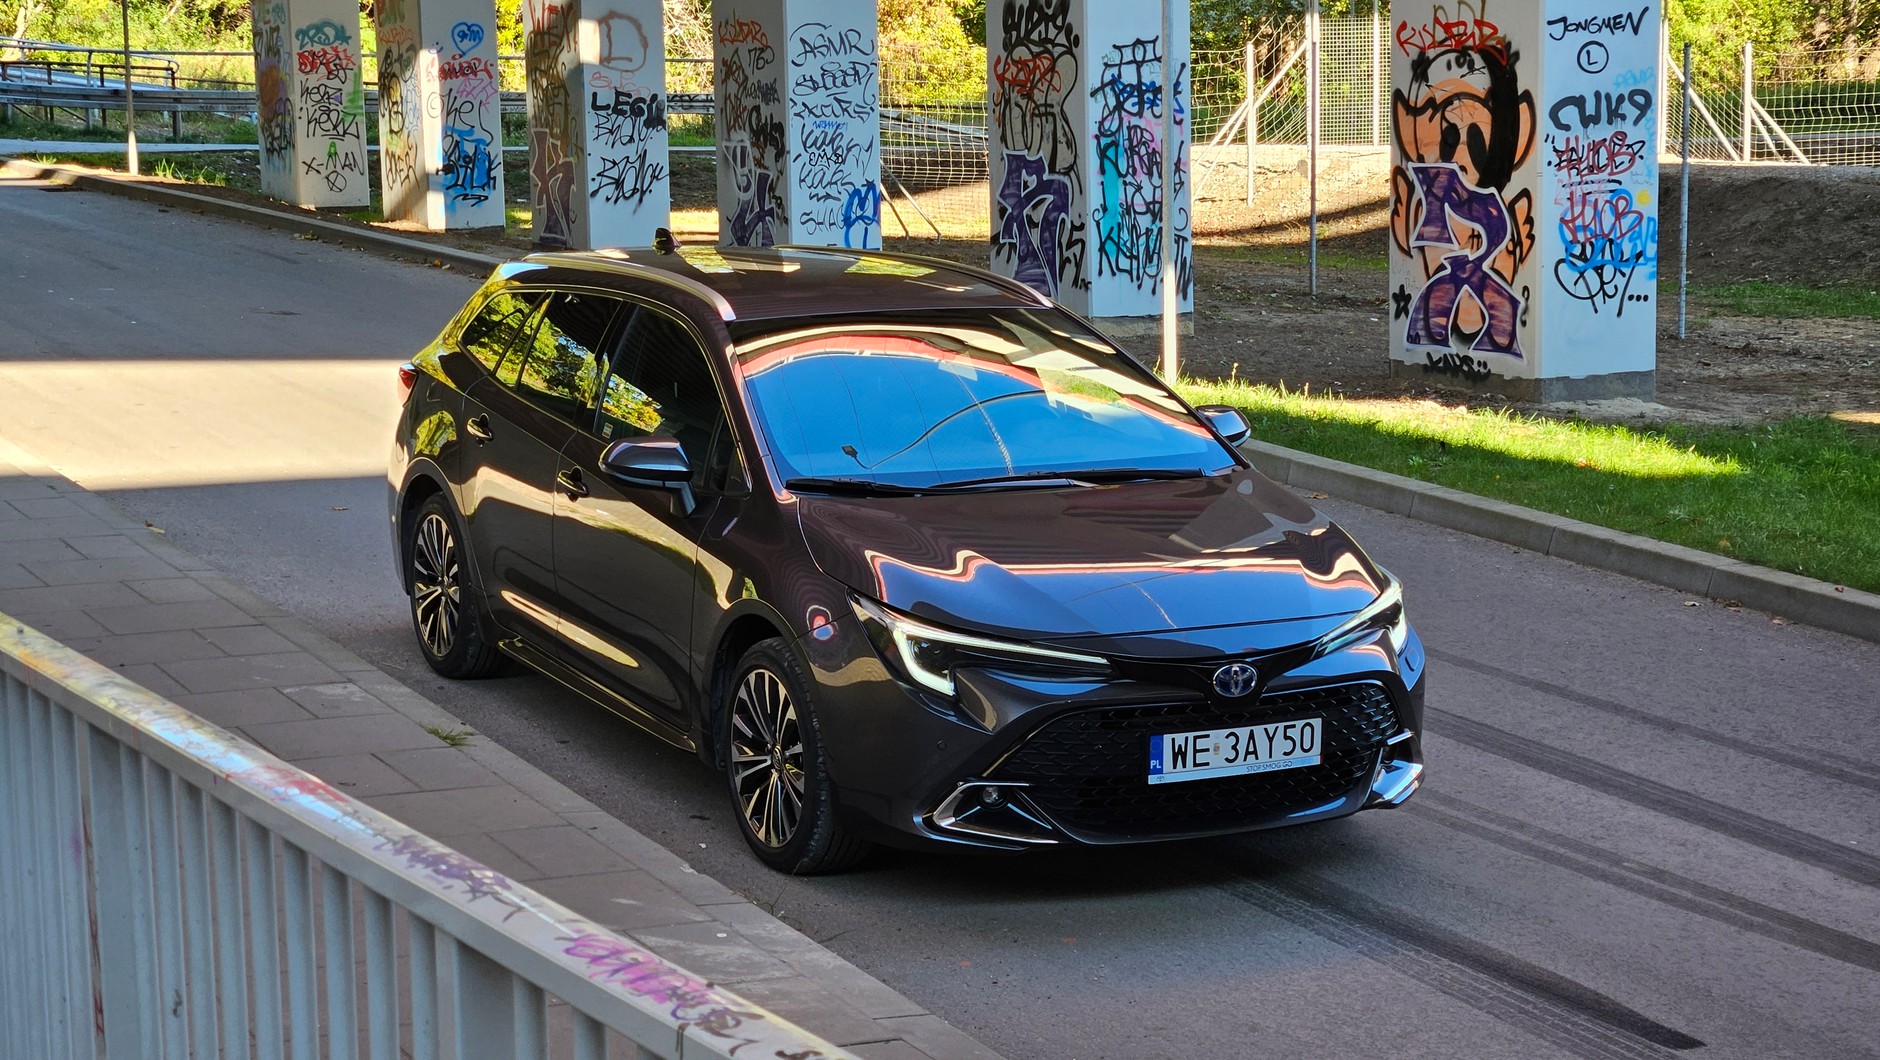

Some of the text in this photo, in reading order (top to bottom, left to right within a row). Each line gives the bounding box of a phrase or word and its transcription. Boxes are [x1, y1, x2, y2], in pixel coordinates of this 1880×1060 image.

[1547, 6, 1649, 41] JONGMEN
[1171, 721, 1316, 770] WE 3AY50
[1150, 760, 1162, 769] PL
